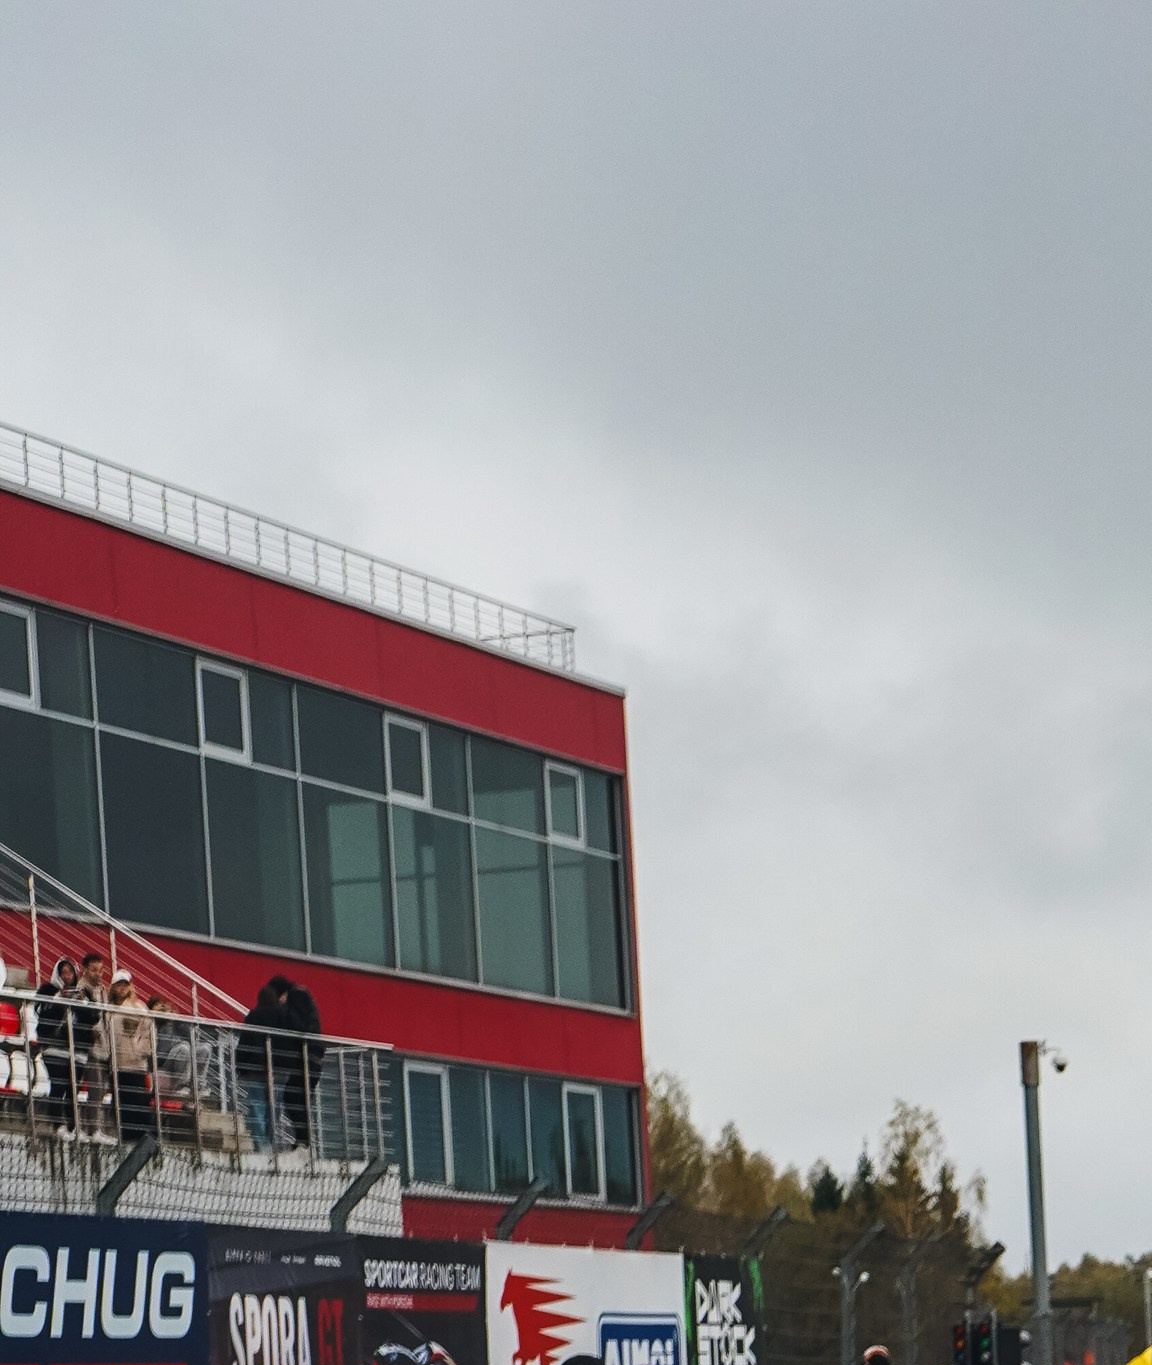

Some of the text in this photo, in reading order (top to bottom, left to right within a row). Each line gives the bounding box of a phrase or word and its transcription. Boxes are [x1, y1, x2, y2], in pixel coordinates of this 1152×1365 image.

[0, 1244, 196, 1339] CHUG
[363, 1258, 419, 1289] SPORTCAR
[419, 1261, 455, 1291] RACING
[455, 1263, 481, 1291] TEAM
